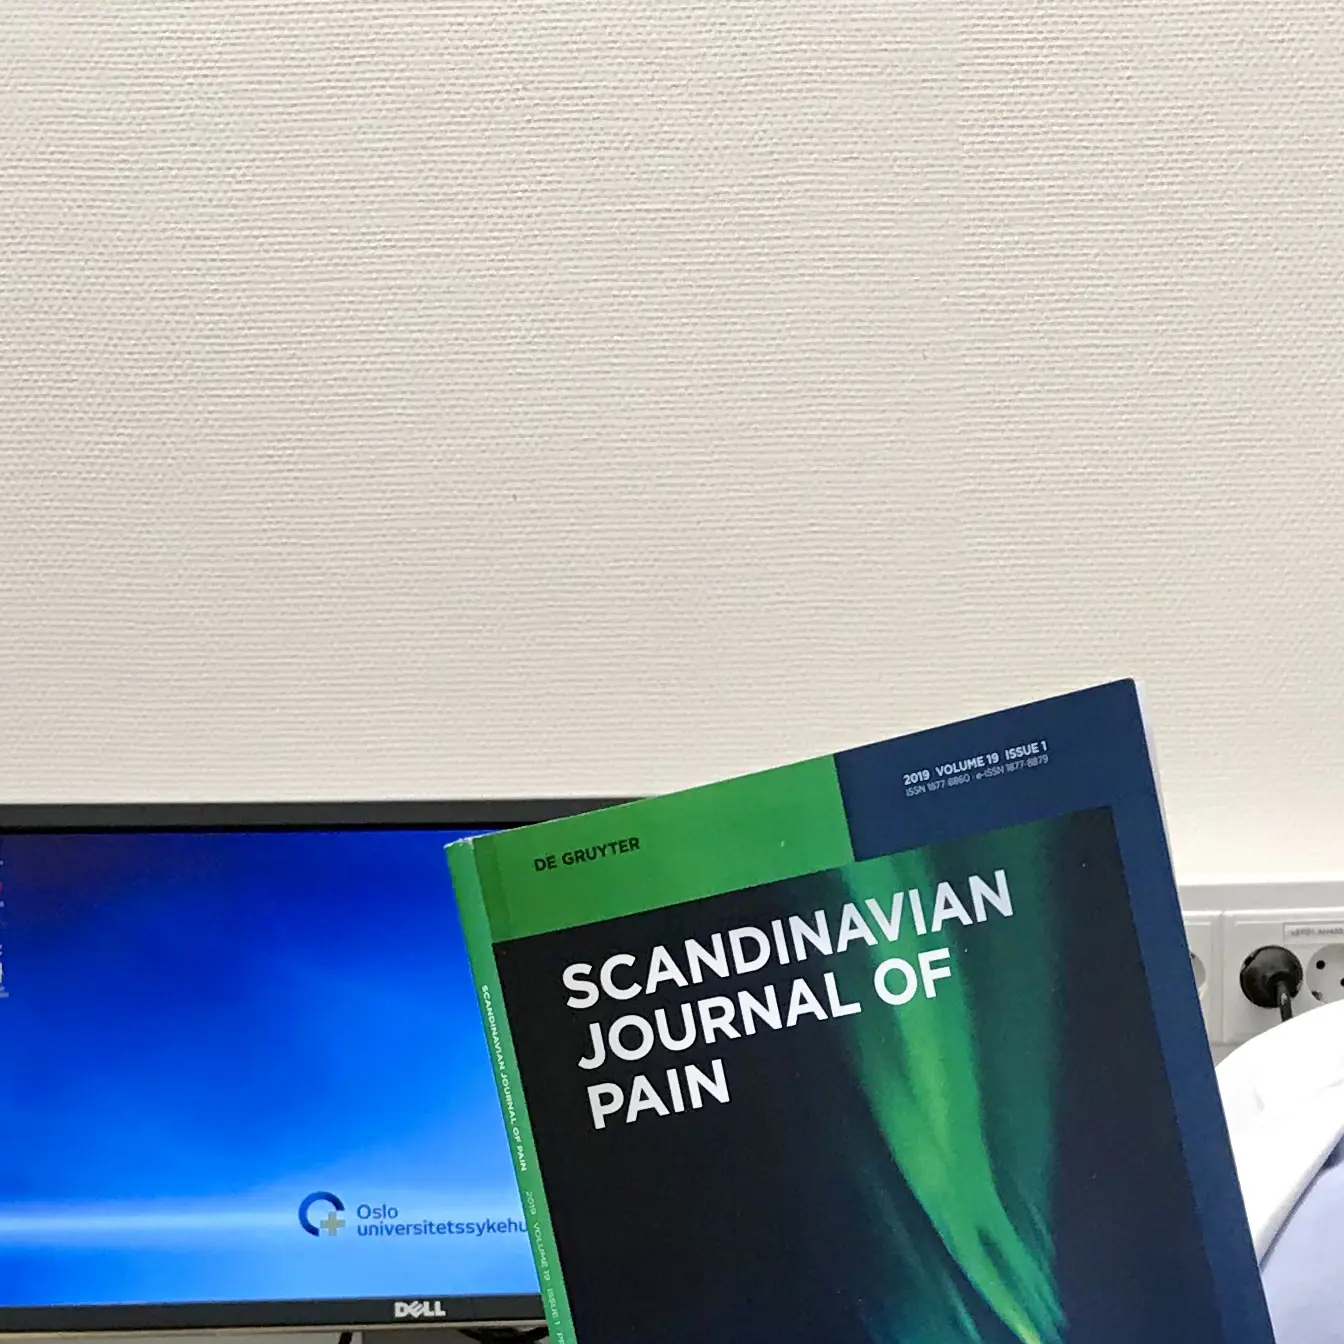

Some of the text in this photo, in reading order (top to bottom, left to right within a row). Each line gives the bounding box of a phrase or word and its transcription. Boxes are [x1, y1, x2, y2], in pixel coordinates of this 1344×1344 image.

[903, 740, 1048, 785] 2019 VOLUME 19 ISSUE 1
[906, 784, 927, 797] ISSN
[534, 837, 640, 872] DE GRUYTER
[562, 869, 1014, 1010] SCANDINAVIAN
[578, 948, 954, 1070] JOURNAL OF
[586, 1059, 730, 1129] PAIN
[481, 984, 506, 1071] SCANDINAVIAN
[500, 1071, 517, 1125] JOURNAL
[512, 1126, 522, 1143] OF
[517, 1145, 528, 1172] PAIN
[526, 1191, 537, 1215] 2019
[533, 1222, 549, 1268] VOLUME
[543, 1270, 551, 1281] 19
[356, 1203, 398, 1220] Oslo
[356, 1217, 528, 1237] universitetssykehu
[394, 1300, 446, 1318] DELL
